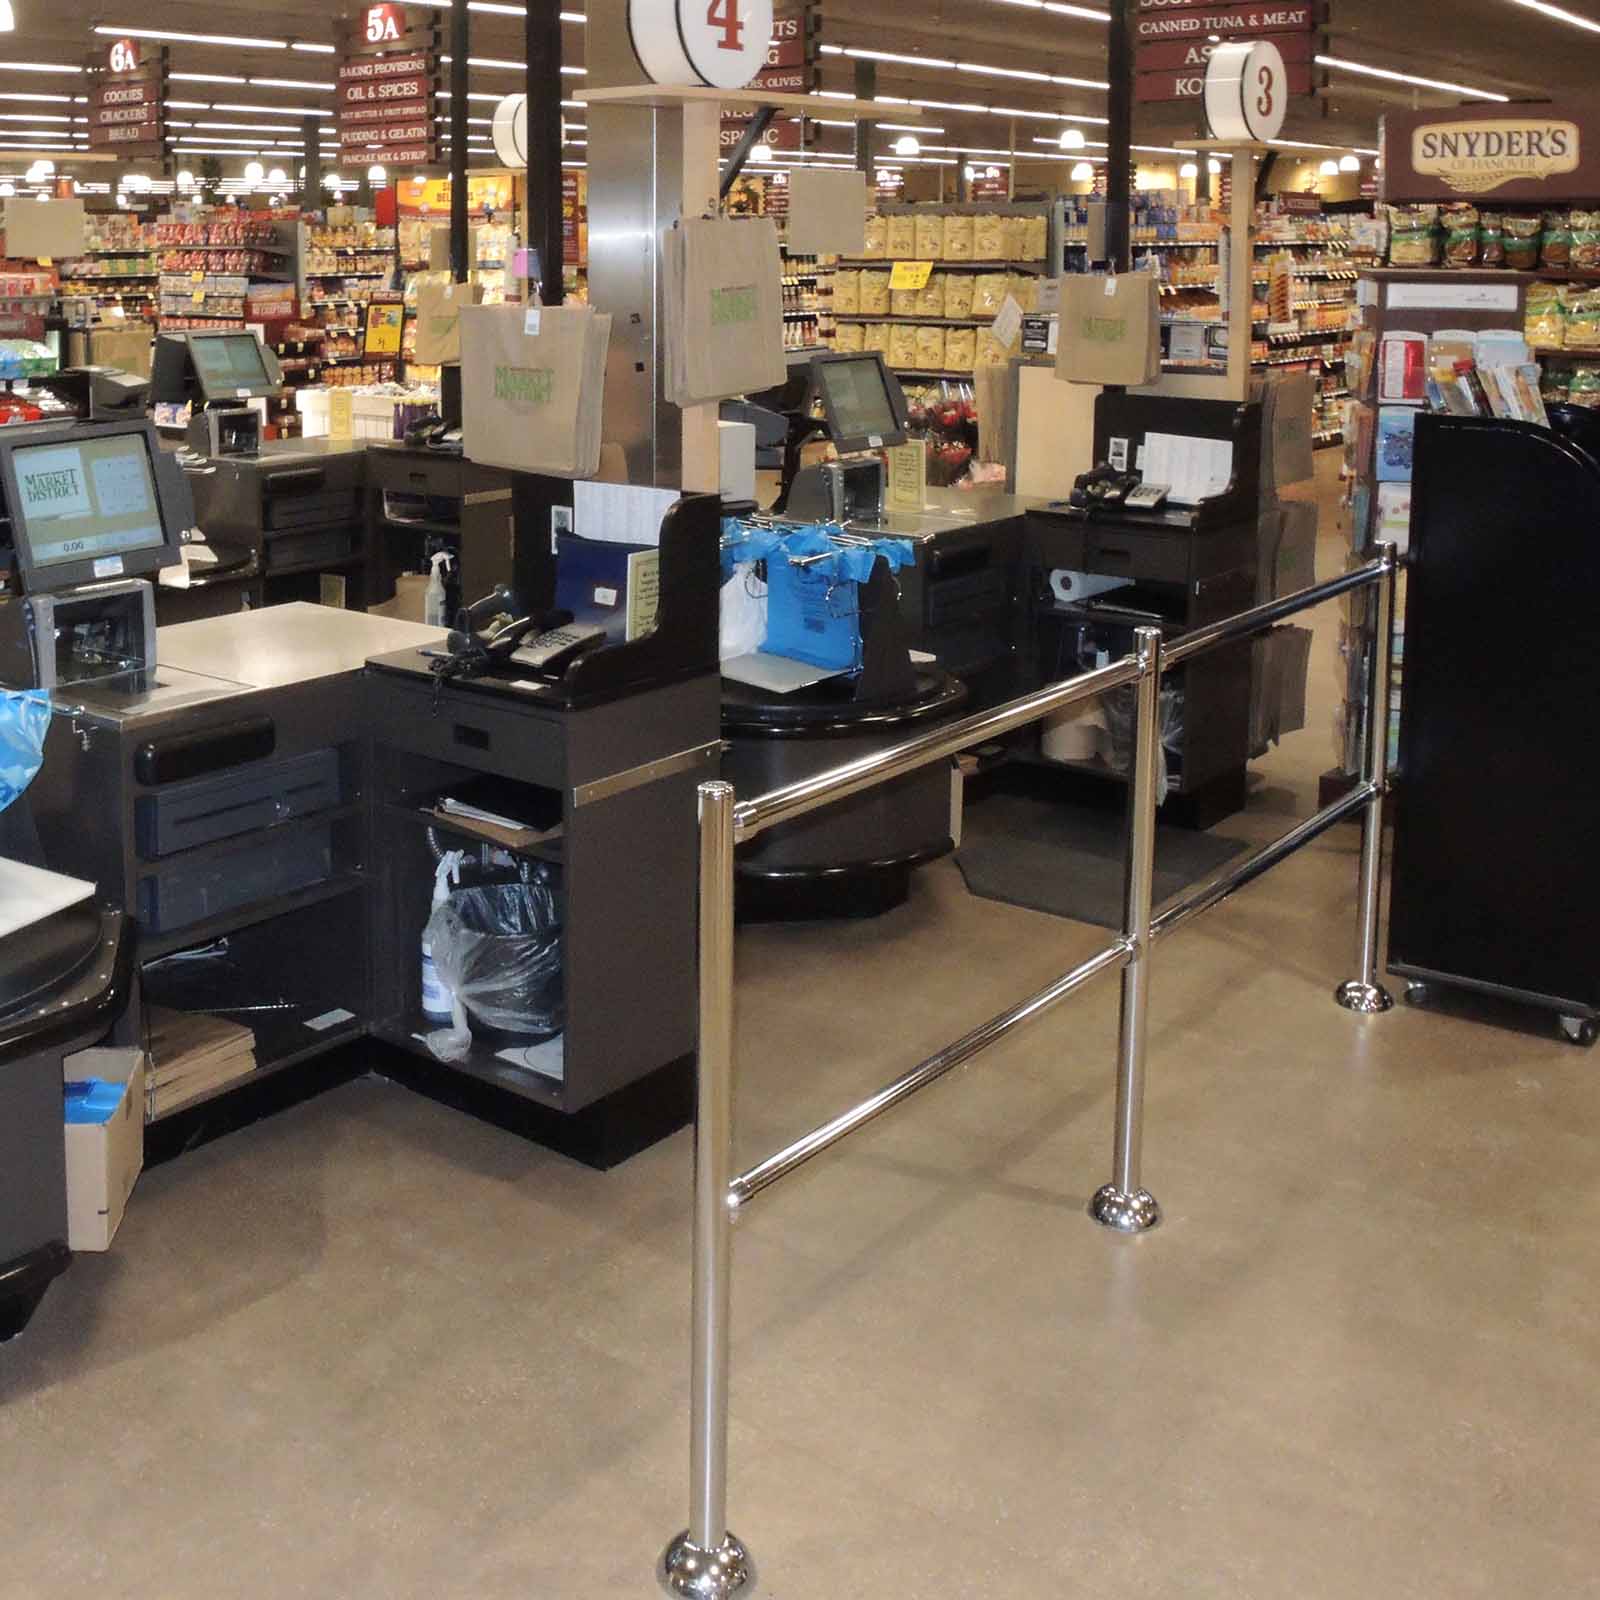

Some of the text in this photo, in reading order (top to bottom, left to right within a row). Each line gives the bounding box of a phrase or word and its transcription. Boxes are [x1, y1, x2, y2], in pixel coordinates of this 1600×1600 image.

[367, 8, 400, 42] 5A
[706, 0, 744, 52] 4
[1139, 10, 1307, 34] CANNED TUNA & MEAT
[110, 42, 137, 73] 6A
[340, 59, 425, 78] BAKING PROVISIONS
[346, 82, 418, 100] OIL & SPICES
[767, 76, 803, 88] OLIVES
[1257, 65, 1273, 117] 3
[103, 88, 144, 103] COOKIES
[100, 108, 148, 122] CRACKERS
[341, 127, 427, 143] PUDDING & GELATIN
[1422, 128, 1567, 158] SNYDER'S
[400, 150, 427, 161] SYRUP
[24, 468, 77, 489] MARKET
